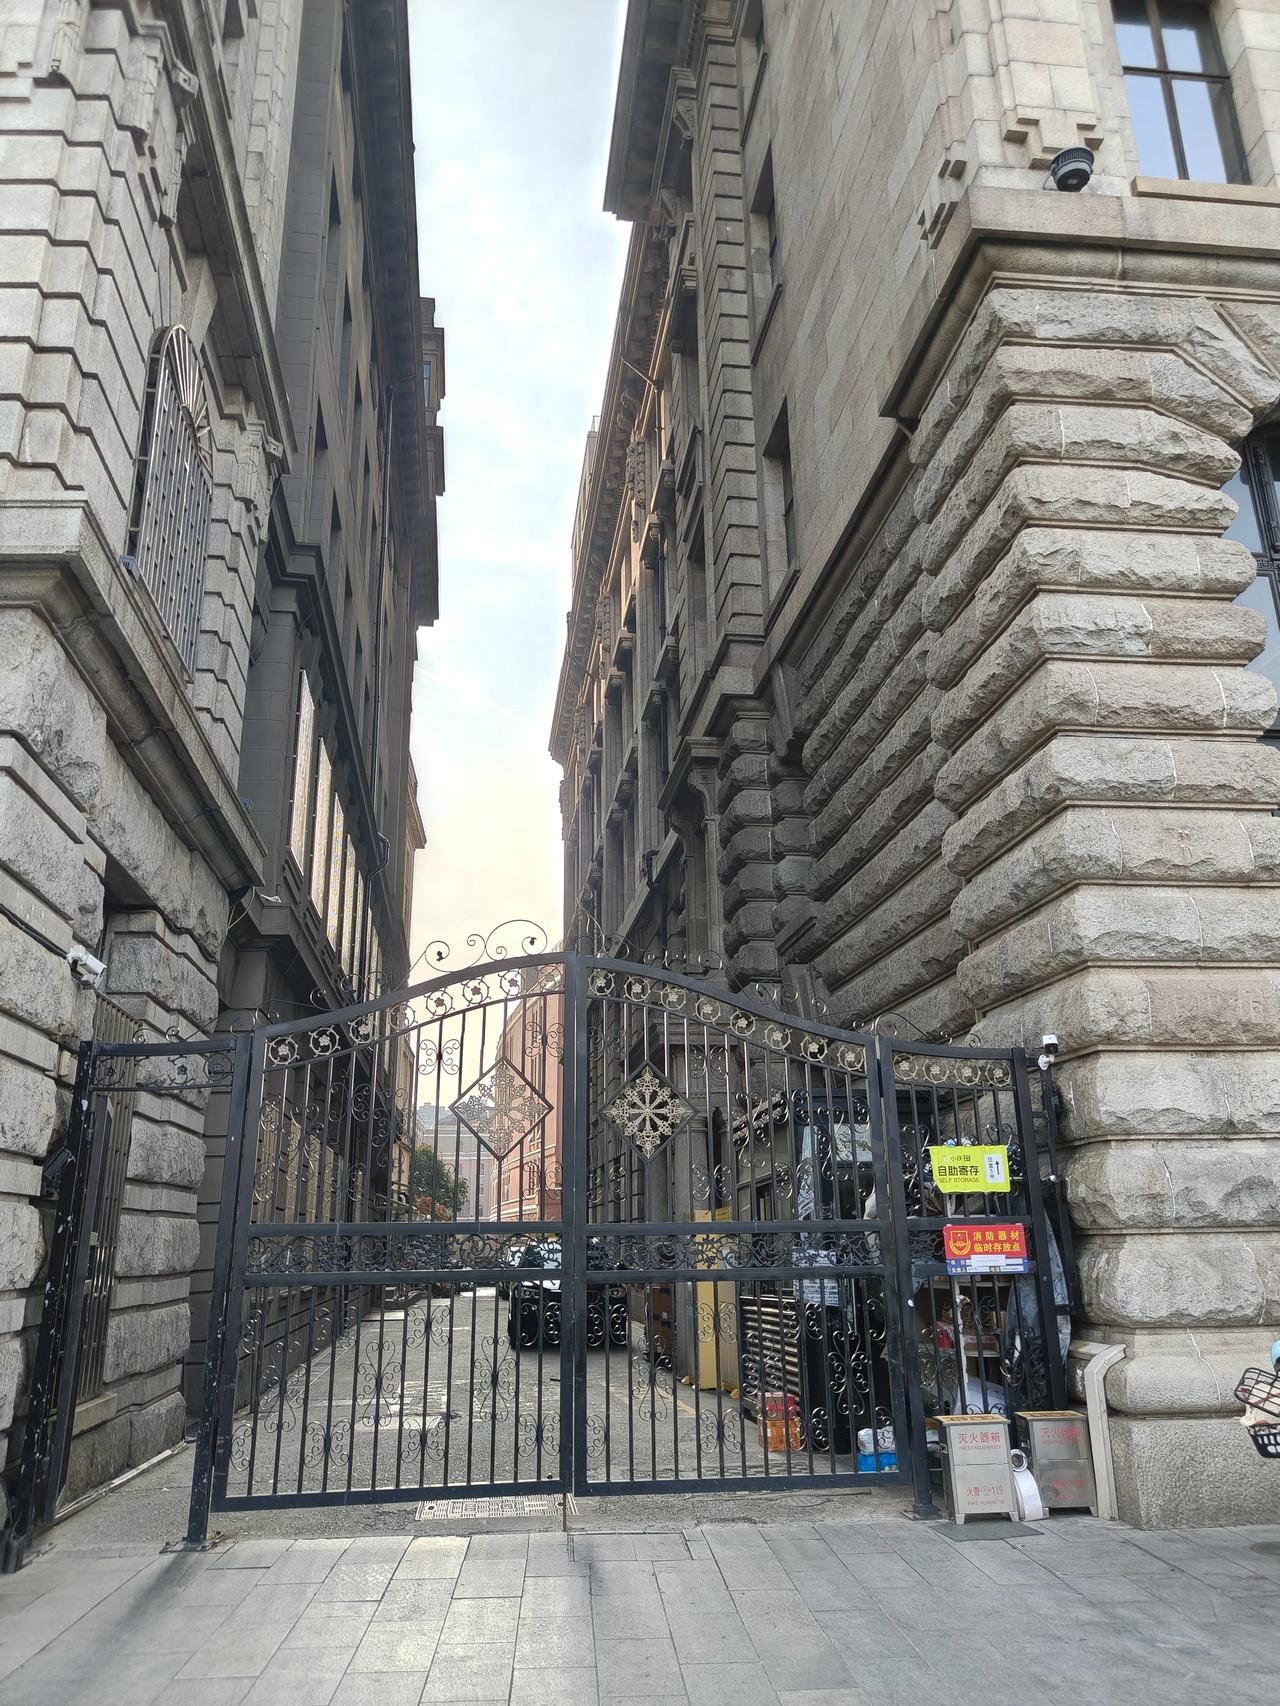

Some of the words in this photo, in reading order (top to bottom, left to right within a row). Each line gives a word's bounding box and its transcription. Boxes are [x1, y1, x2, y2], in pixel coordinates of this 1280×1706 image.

[938, 1165, 979, 1177] 自助寄存
[973, 1231, 1019, 1241] 消防器材
[973, 1242, 1022, 1253] 临时存放点
[958, 1431, 1001, 1443] 灭火器箱
